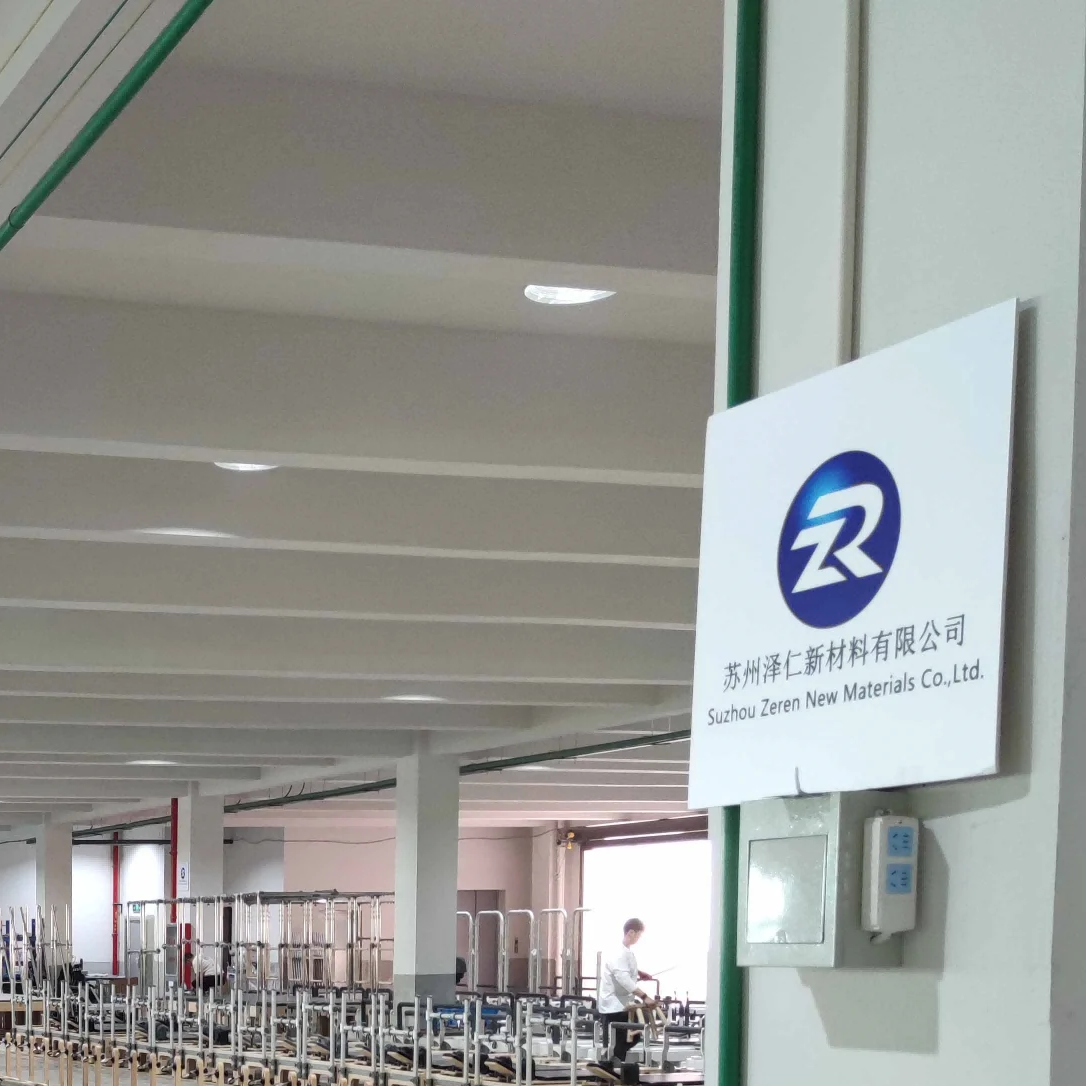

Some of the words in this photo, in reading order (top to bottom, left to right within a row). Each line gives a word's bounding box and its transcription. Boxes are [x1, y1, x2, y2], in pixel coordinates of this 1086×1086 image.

[723, 613, 965, 693] 苏州泽仁新材料有限公司
[707, 704, 756, 726] Suzhou
[760, 697, 800, 717] Zeren
[805, 690, 839, 709] New
[843, 672, 915, 702] Materials
[920, 658, 984, 689] Co.,Ltd.
